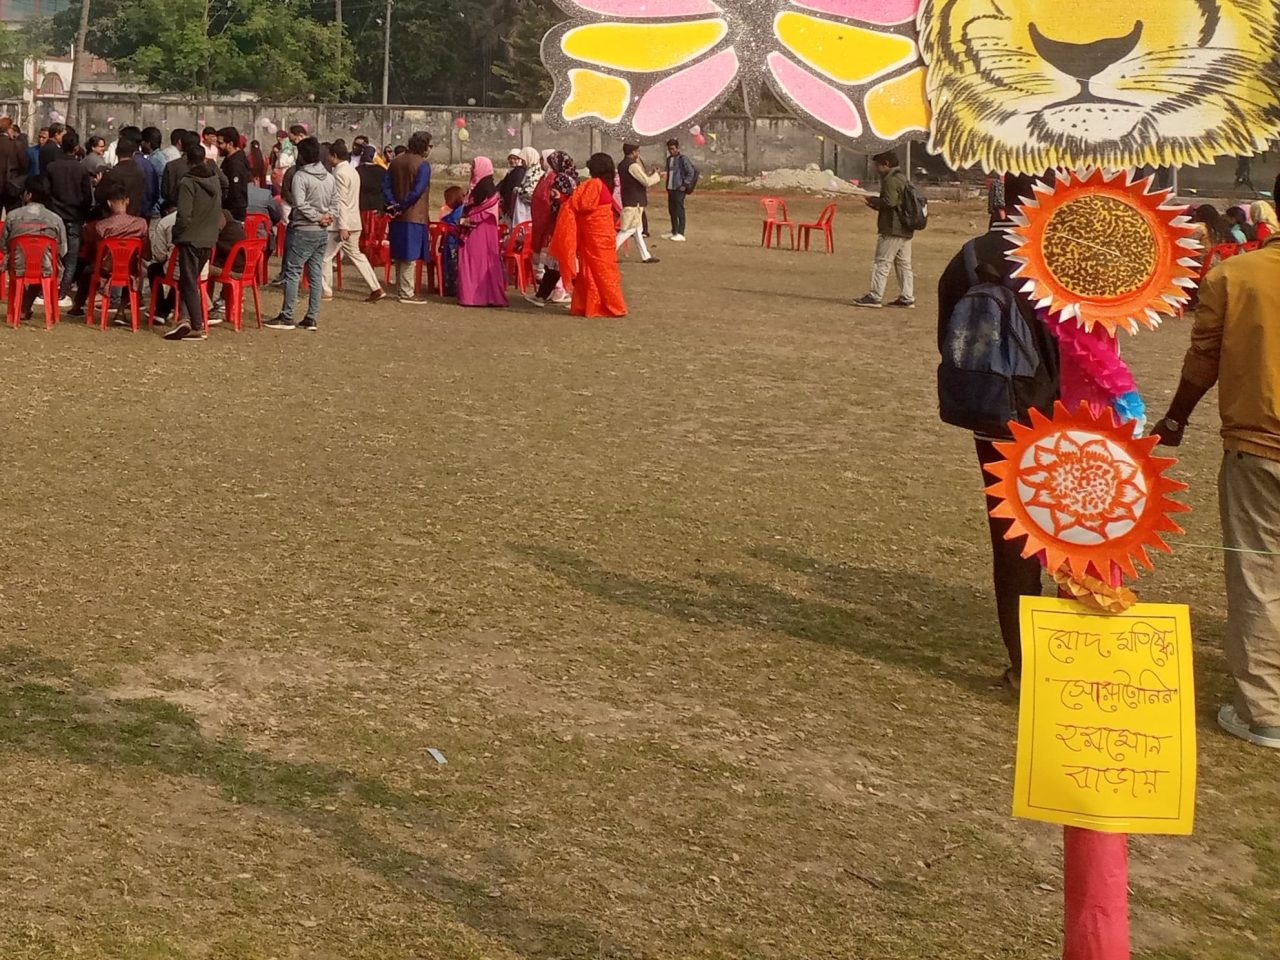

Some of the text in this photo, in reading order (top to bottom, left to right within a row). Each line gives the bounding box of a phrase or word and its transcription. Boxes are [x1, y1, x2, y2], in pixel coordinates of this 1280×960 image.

[1038, 627, 1111, 664] রোদ
[1055, 723, 1173, 762] হরমোন
[1061, 764, 1171, 798] বাড়ায়
